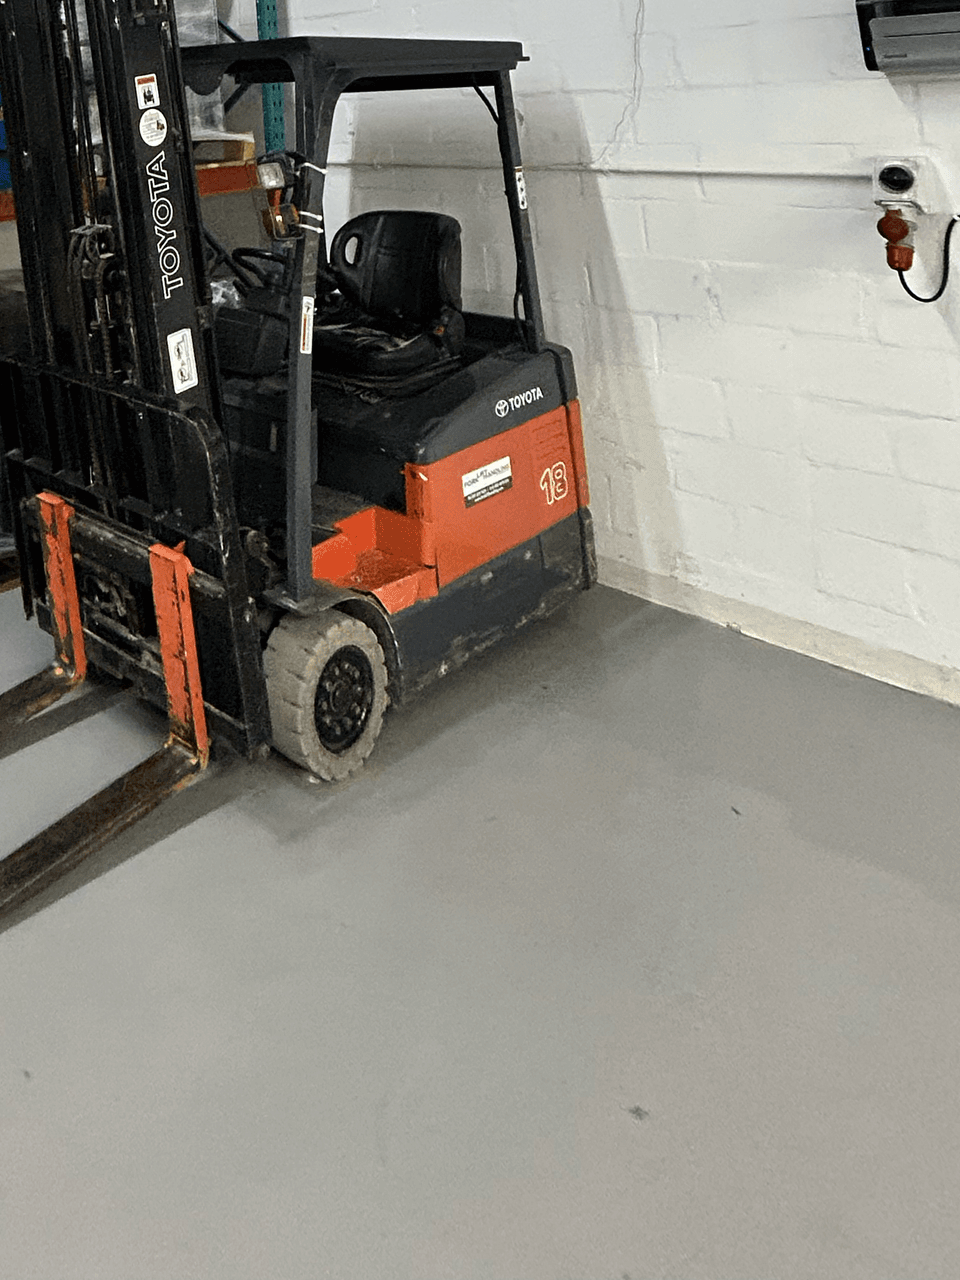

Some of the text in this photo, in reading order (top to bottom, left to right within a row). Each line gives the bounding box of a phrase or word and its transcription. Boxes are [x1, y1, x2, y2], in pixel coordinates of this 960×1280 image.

[146, 150, 184, 300] TOYOTA
[508, 387, 544, 411] TOYOTA
[540, 461, 568, 505] 18
